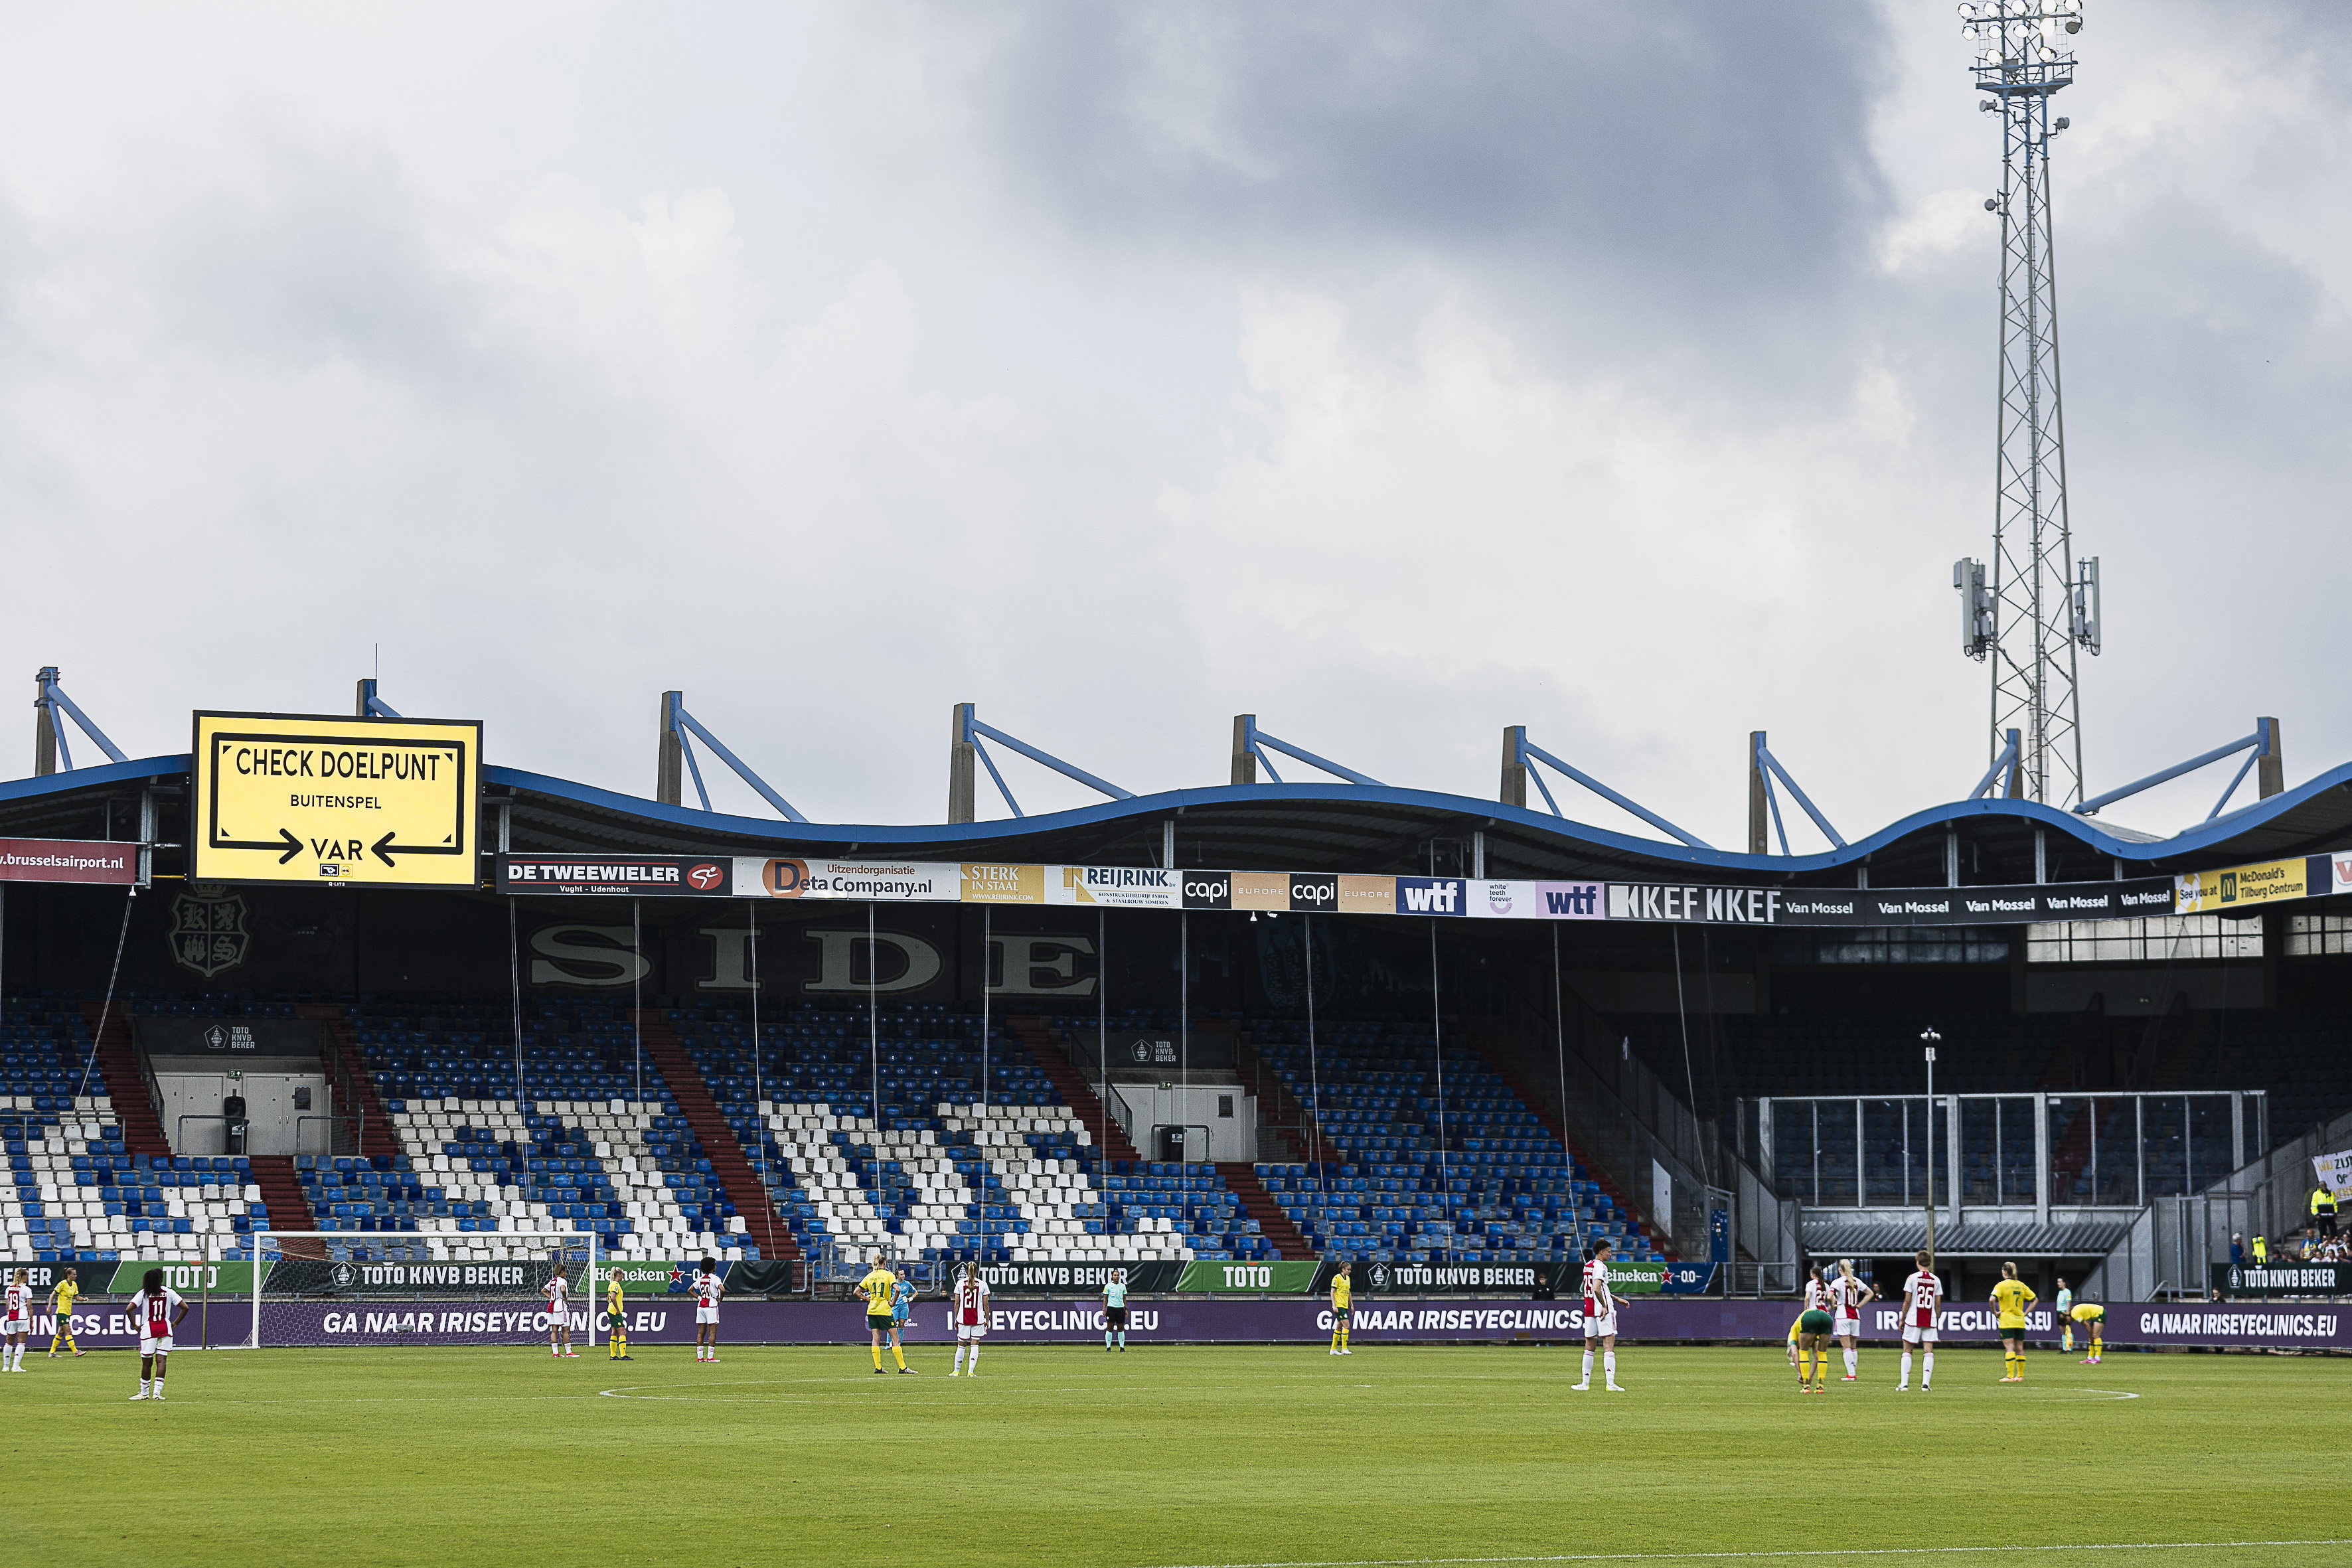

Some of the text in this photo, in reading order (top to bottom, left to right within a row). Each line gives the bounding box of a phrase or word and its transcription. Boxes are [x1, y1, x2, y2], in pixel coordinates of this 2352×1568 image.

[236, 748, 439, 781] CHECK DOELPUNT
[291, 794, 382, 809] BUITENSPEL
[311, 838, 362, 860] VAR
[509, 865, 680, 882] DE TWEEWIELER
[827, 864, 915, 876] Uitzendorganisatie
[972, 866, 1019, 881] STERK
[1088, 868, 1168, 888] REIJRINK
[2240, 868, 2285, 884] McDonald's
[775, 862, 932, 897] Deta Company.nl
[973, 881, 1019, 892] IN STAAL
[560, 885, 583, 894] Vught
[1185, 880, 1227, 903] capi
[1238, 887, 1285, 896] EUROPE
[1293, 882, 1334, 905] capi
[1405, 882, 1458, 912] wtf
[2121, 890, 2171, 906] Van Mossel
[2179, 886, 2217, 900] See you at
[2240, 882, 2304, 899] Tilburg Centrum
[1546, 886, 1597, 914] wtf
[1786, 902, 1853, 914] Van Mossel
[1878, 901, 1950, 913] Van Mossel
[1966, 898, 2035, 911] Van Mossel
[2047, 895, 2108, 909] Van Mossel
[531, 925, 1099, 997] SIDE
[2336, 1174, 2348, 1184] OP
[163, 1266, 217, 1288] TOTO
[362, 1266, 524, 1285] TOTO KNVB BEKER
[595, 1268, 665, 1281] Heneken
[979, 1267, 1128, 1285] TOTO KNVB BEKER
[1223, 1267, 1271, 1287] TOTO
[1395, 1267, 1535, 1285] TOTO KNVB BEKER
[1607, 1269, 1658, 1282] eineken
[2244, 1269, 2335, 1287] TOTO KNVB BEKER
[701, 1284, 710, 1299] 20
[964, 1289, 977, 1308] 21
[1847, 1288, 1857, 1306] 10
[1917, 1286, 1934, 1310] 26
[9, 1293, 19, 1310] 19
[153, 1300, 163, 1322] 11
[947, 1310, 1158, 1330] IEYECLINIC.EU
[1352, 1310, 1414, 1330] NAAR
[1418, 1310, 1585, 1330] IRISEYECLINICS.
[0, 1314, 141, 1336] INCS.EU
[323, 1311, 666, 1333] GA NAAR IRISEYECNC.EU
[2140, 1313, 2337, 1336] GA NAAR IRISEYECLINICS.EU
